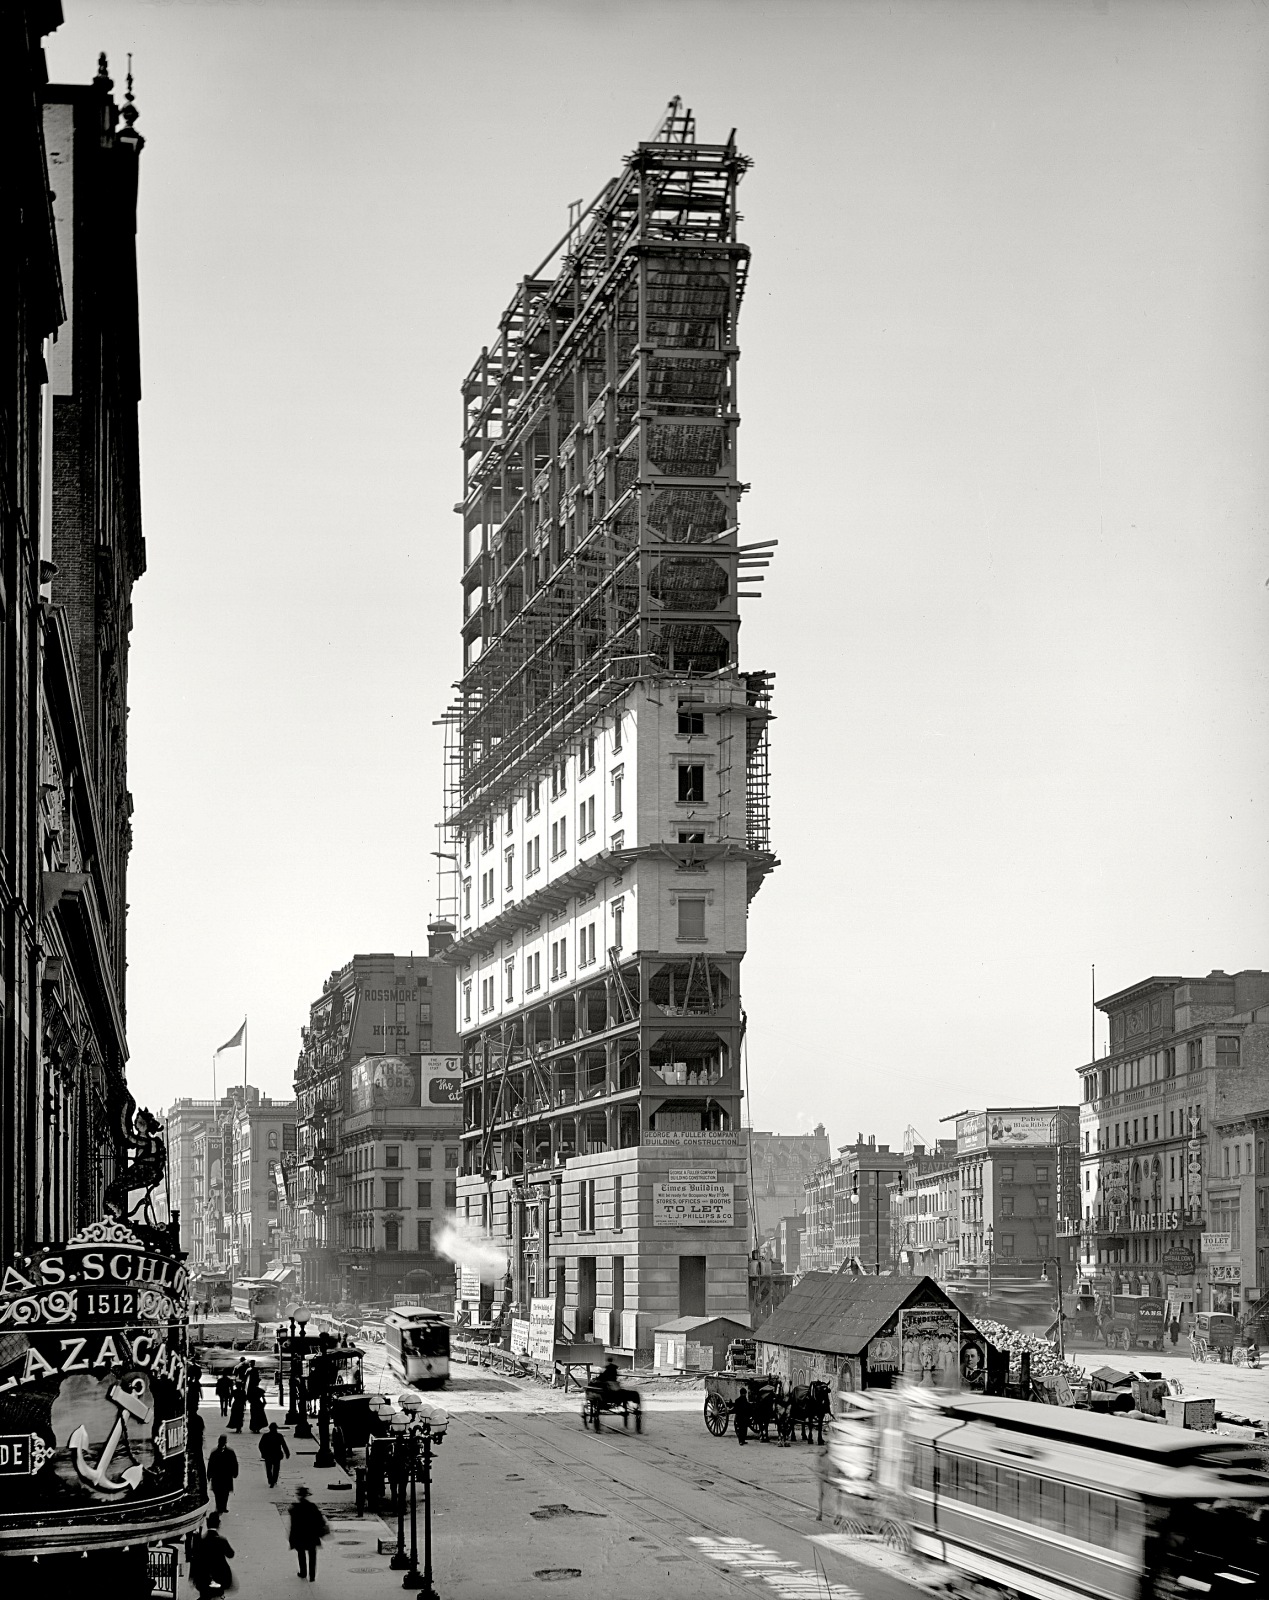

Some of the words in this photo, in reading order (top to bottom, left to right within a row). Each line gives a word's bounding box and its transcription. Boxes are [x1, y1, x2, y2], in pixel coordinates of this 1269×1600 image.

[364, 989, 418, 1002] ROSSMORE
[372, 1025, 410, 1036] HOTEL
[380, 1063, 404, 1075] THE
[374, 1077, 411, 1089] GLOBE
[644, 1131, 670, 1139] GEORGE
[661, 1183, 687, 1192] Times
[688, 1183, 725, 1193] Building
[663, 1205, 685, 1213] TO
[690, 1205, 724, 1213] LET
[1130, 1210, 1178, 1232] VARIETIES
[82, 1253, 190, 1300] SCHLO
[87, 1293, 134, 1315] 1512
